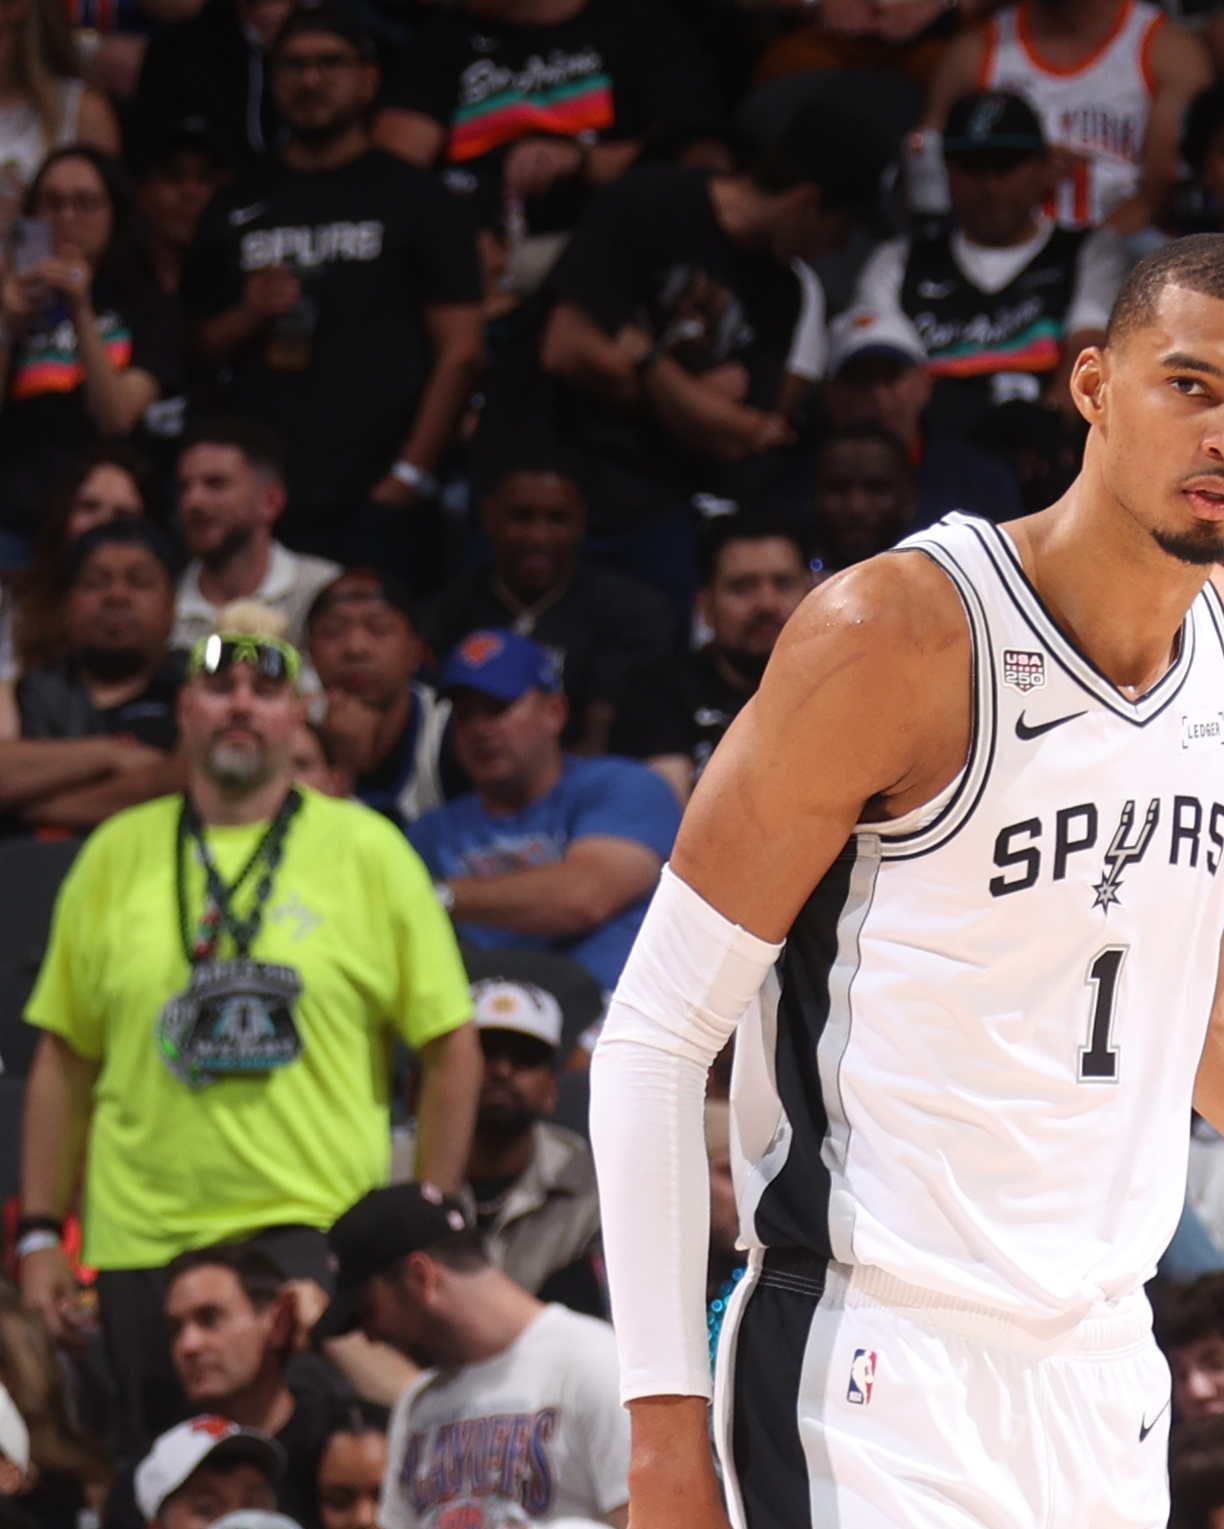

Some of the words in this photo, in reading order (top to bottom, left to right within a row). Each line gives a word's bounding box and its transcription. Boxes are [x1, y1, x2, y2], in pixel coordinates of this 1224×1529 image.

[1005, 653, 1042, 666] USA
[1004, 672, 1044, 685] 250
[1187, 722, 1221, 740] LEDGER
[1076, 943, 1131, 1085] 1
